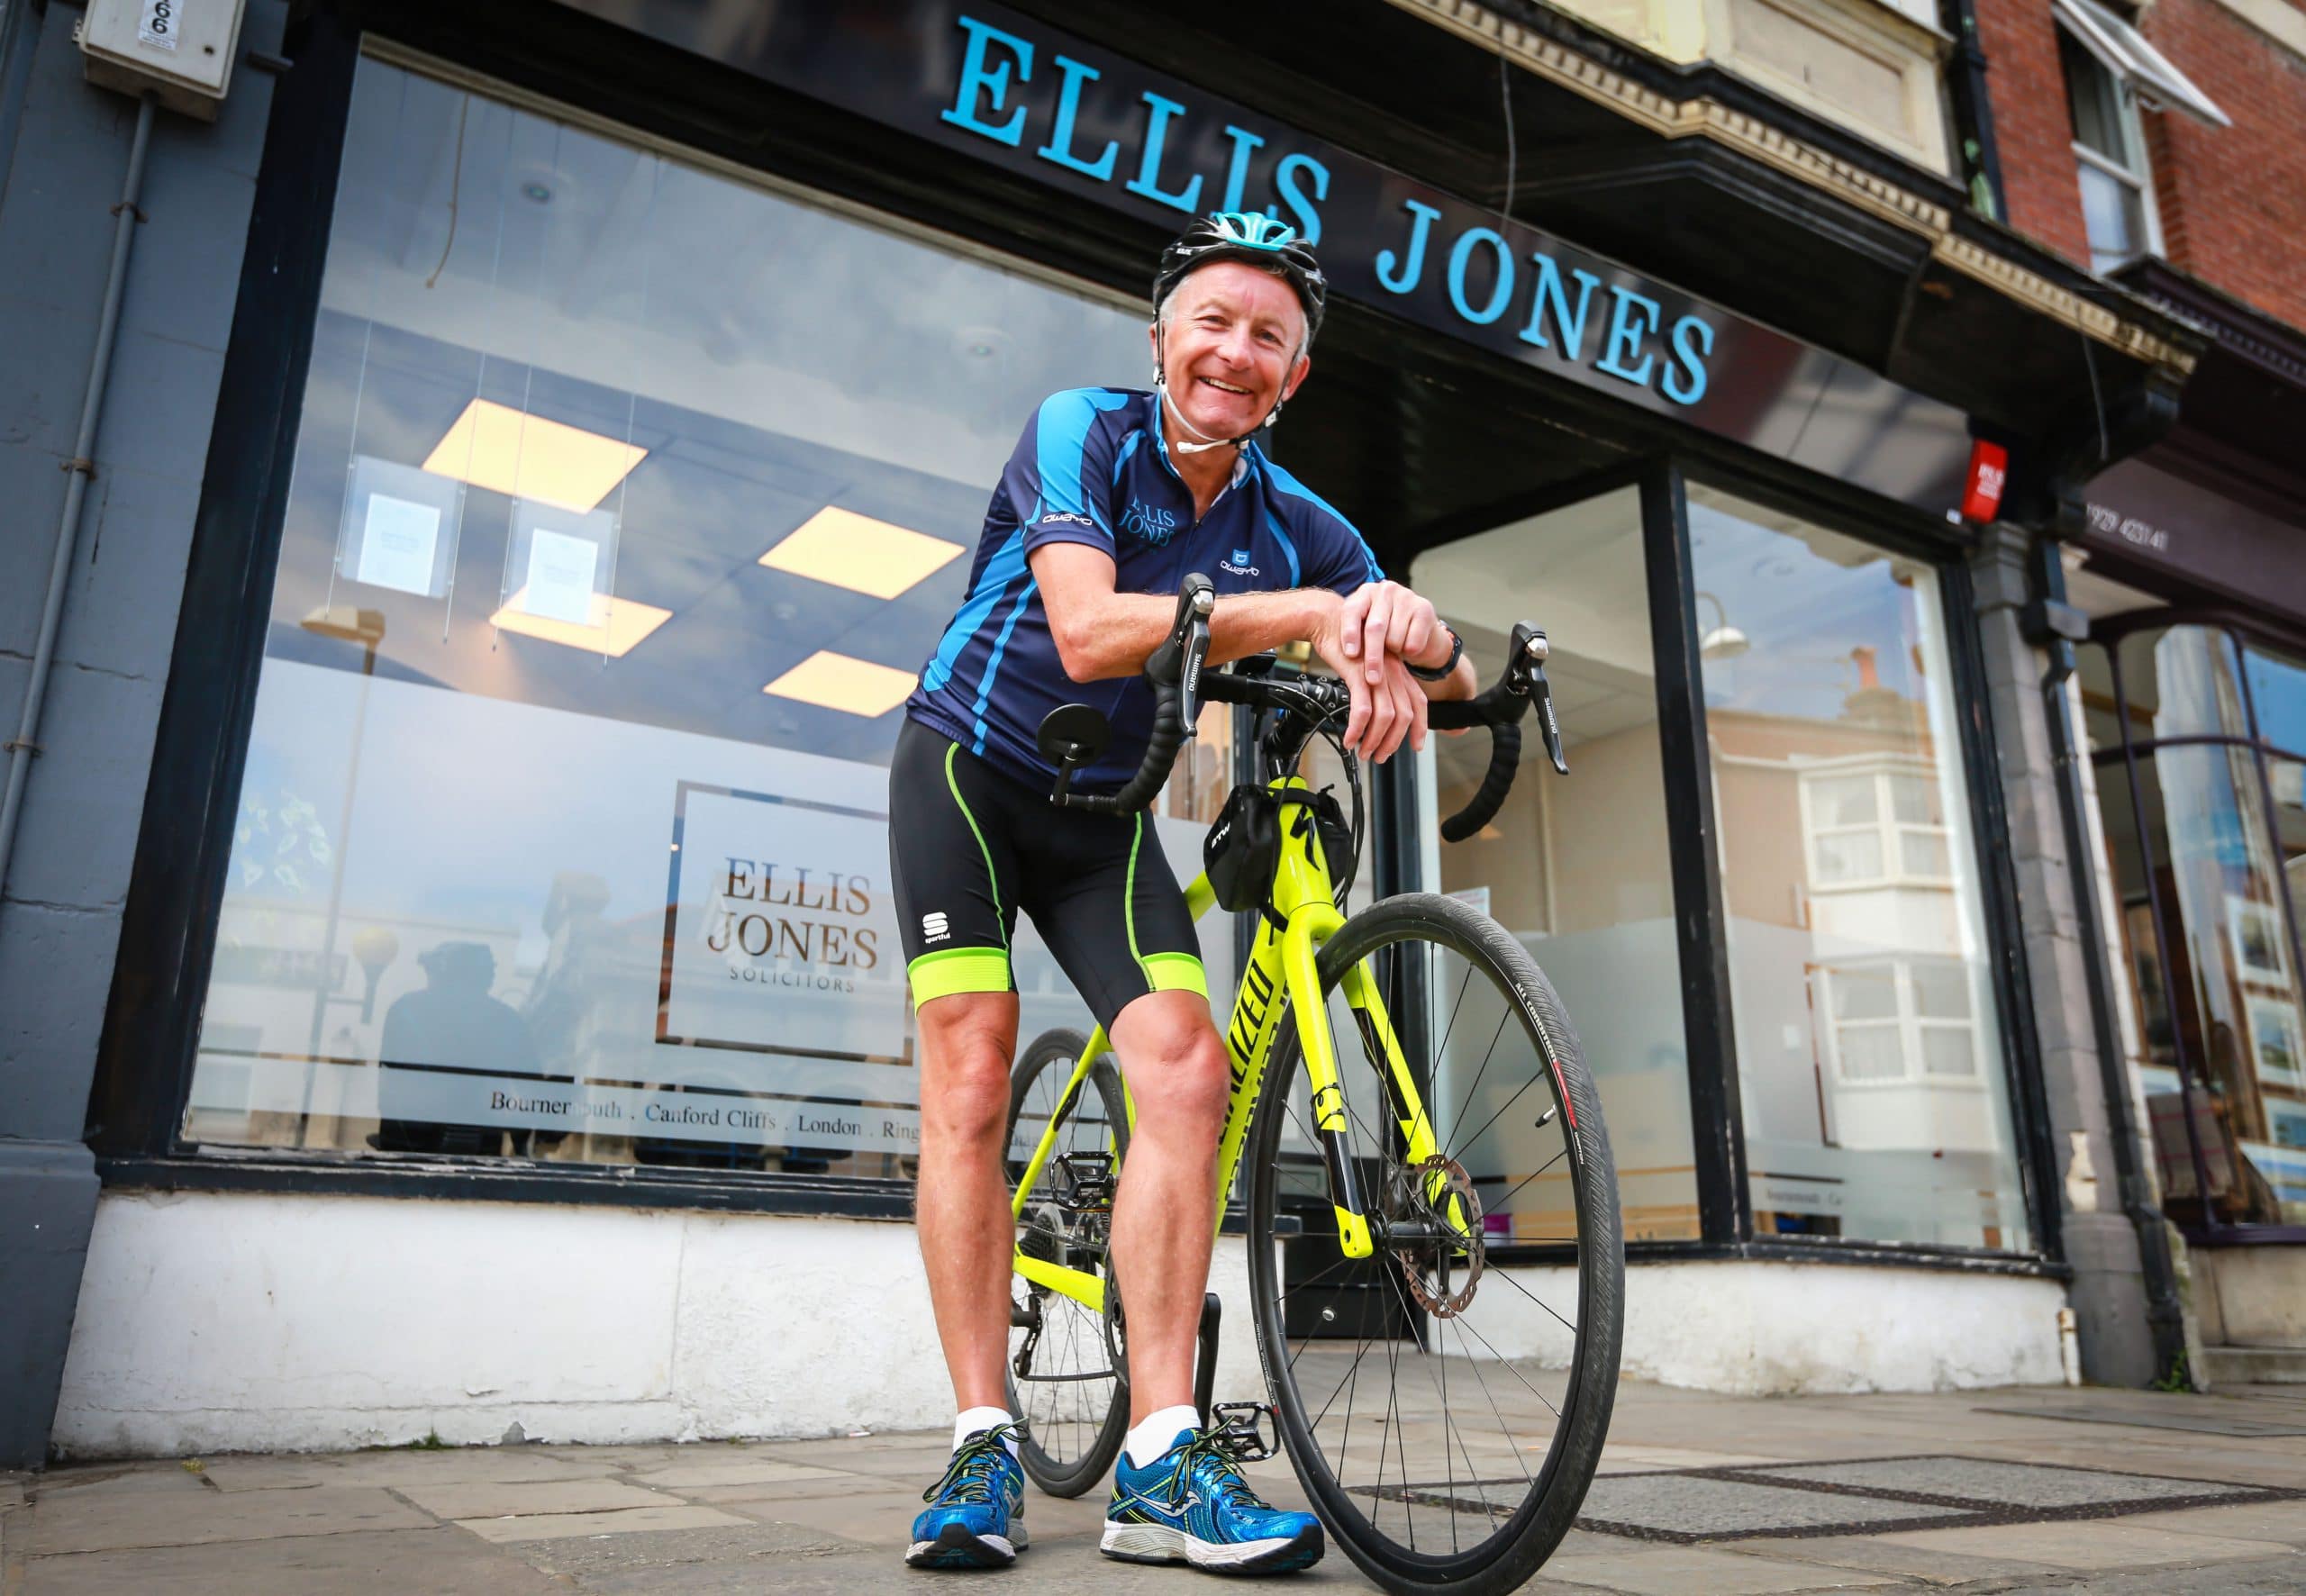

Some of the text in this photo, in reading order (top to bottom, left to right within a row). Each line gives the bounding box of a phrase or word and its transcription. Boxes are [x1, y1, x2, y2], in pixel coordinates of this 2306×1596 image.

[151, 0, 171, 34] 66
[941, 15, 1714, 406] ELLIS JONES
[1188, 653, 1202, 692] SHIMANO
[1544, 697, 1557, 734] SHIMANO
[722, 857, 871, 916] ELLIS
[708, 911, 878, 970] JONES
[798, 1114, 862, 1136] London
